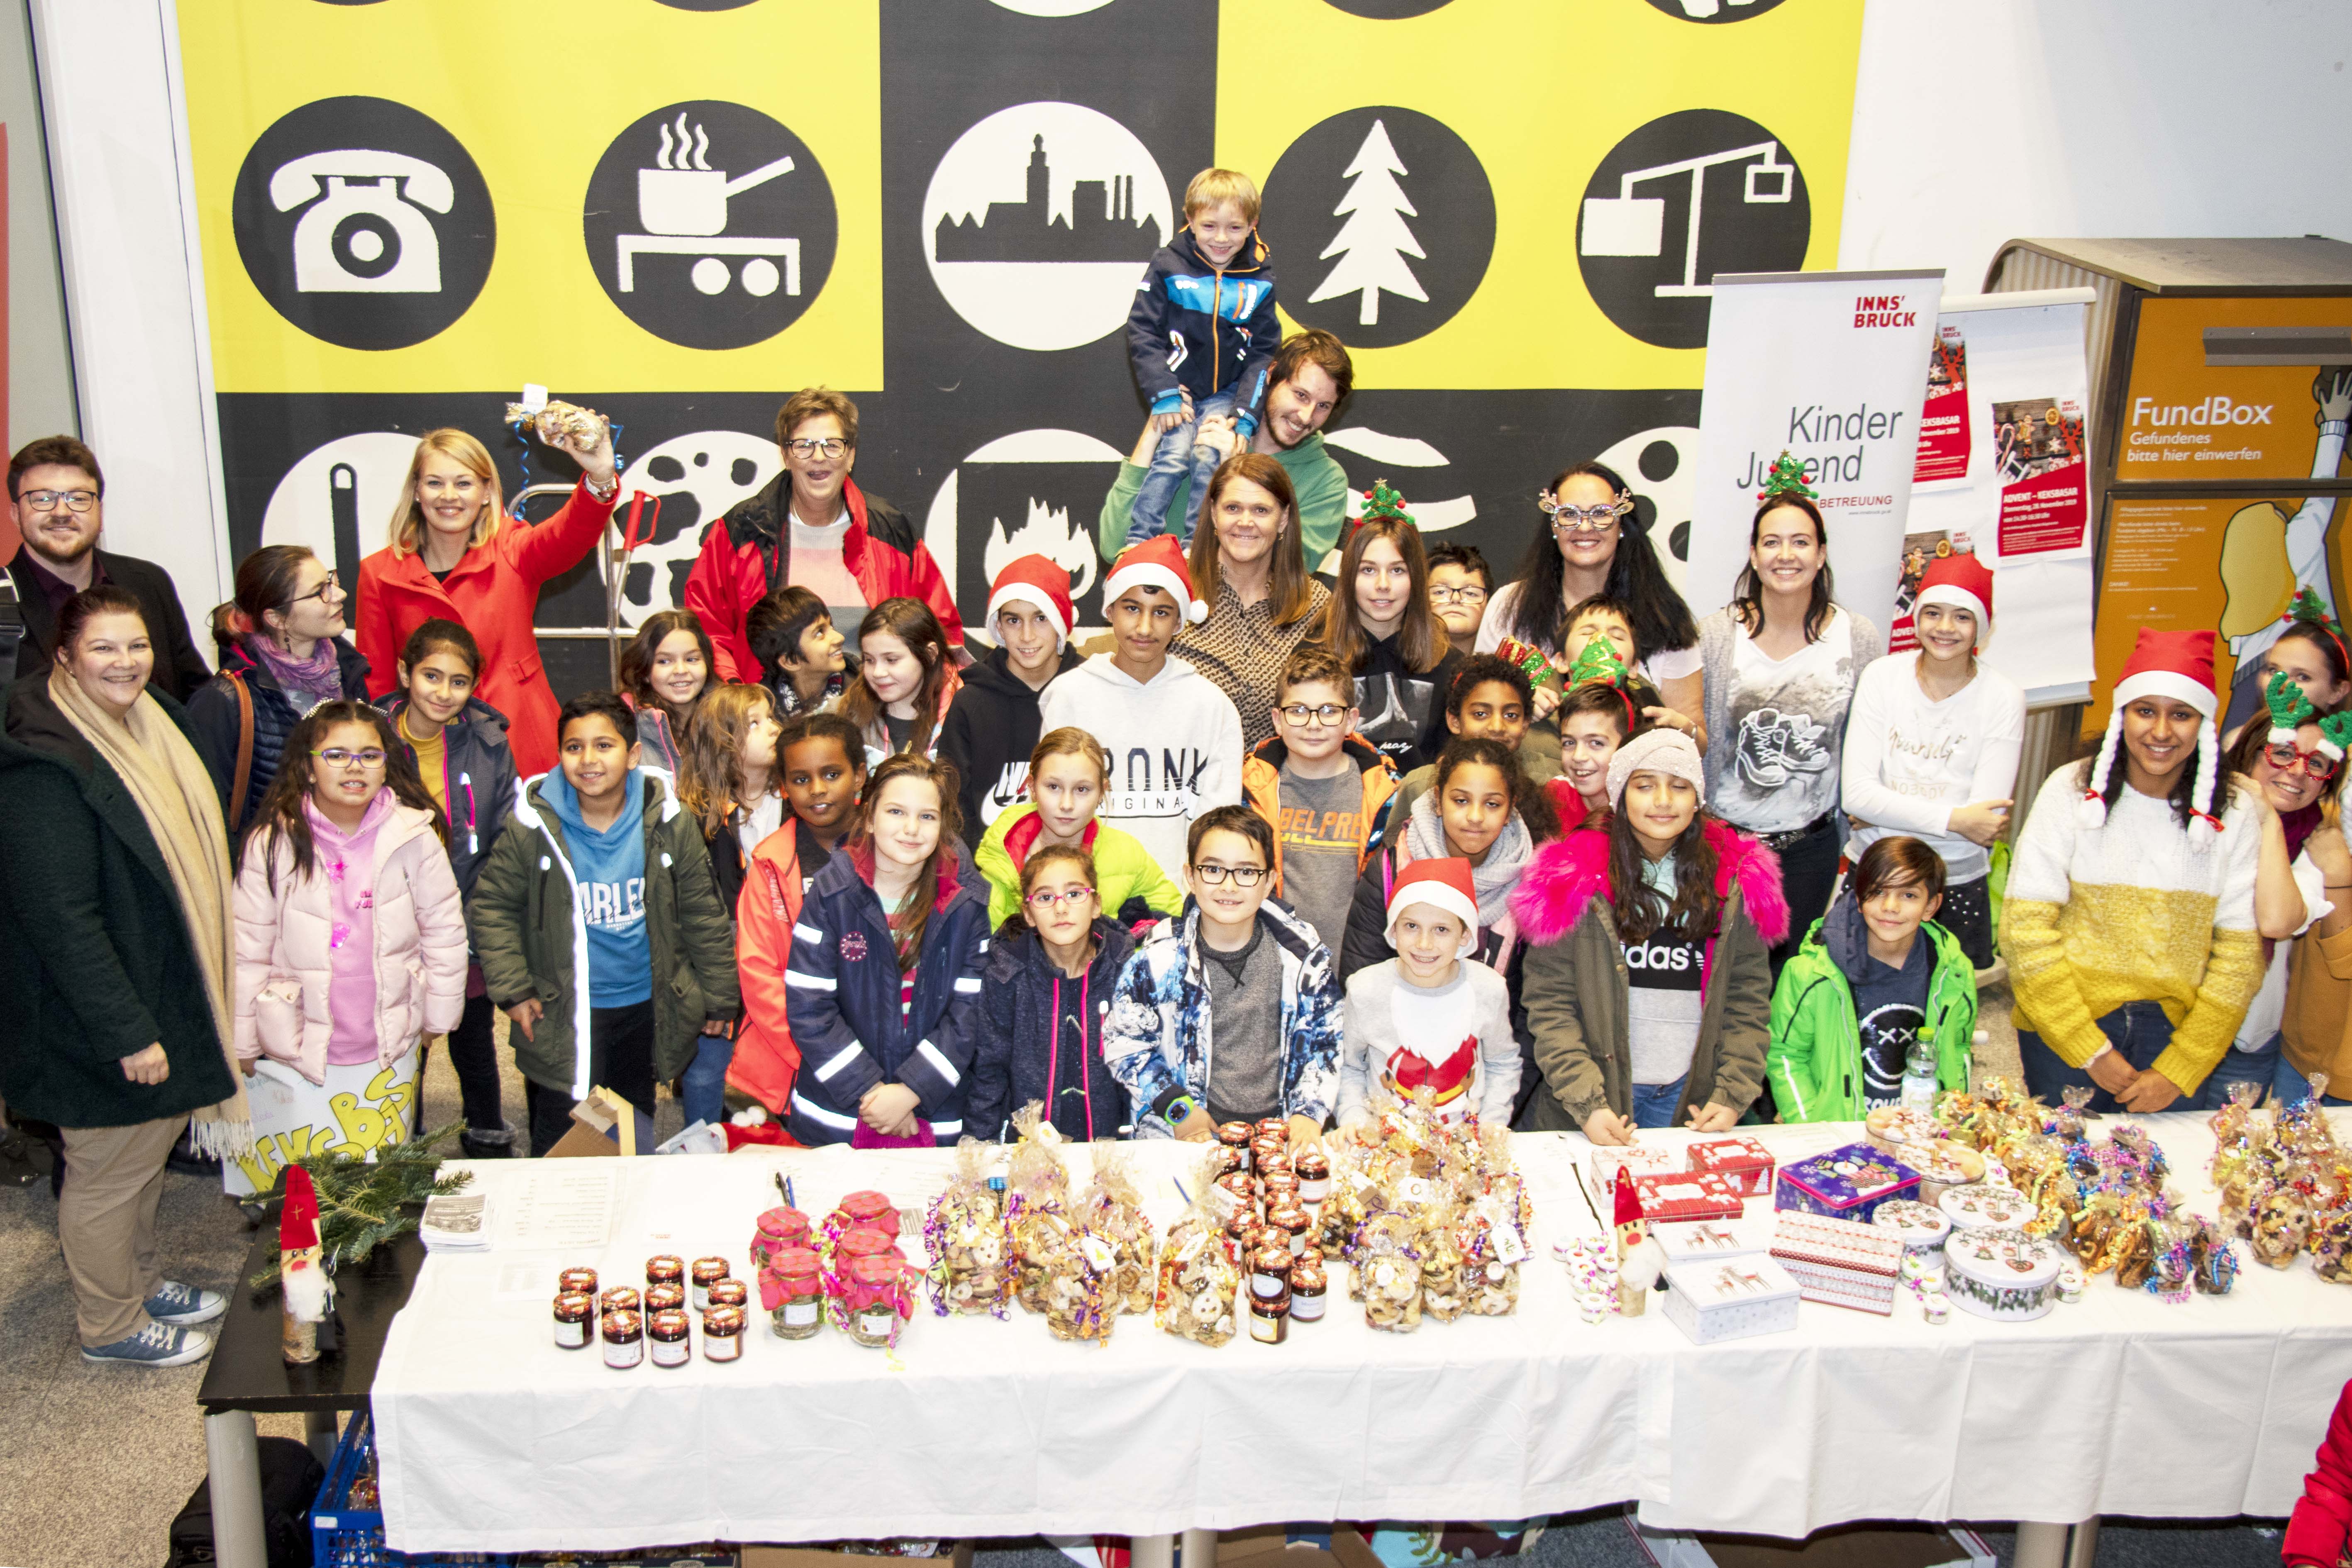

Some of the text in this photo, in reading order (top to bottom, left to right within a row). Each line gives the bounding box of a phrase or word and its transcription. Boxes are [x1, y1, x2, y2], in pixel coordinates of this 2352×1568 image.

[1856, 295, 1906, 311] INNS'
[1854, 312, 1916, 328] BRUCK
[2132, 396, 2274, 426] FundBox
[1788, 403, 1903, 443] Kinder
[2130, 431, 2213, 445] Gefundenes
[2127, 446, 2262, 462] bitte hier einwerfen
[1737, 445, 1864, 489] Juend
[1819, 495, 1892, 508] BETREUUNG
